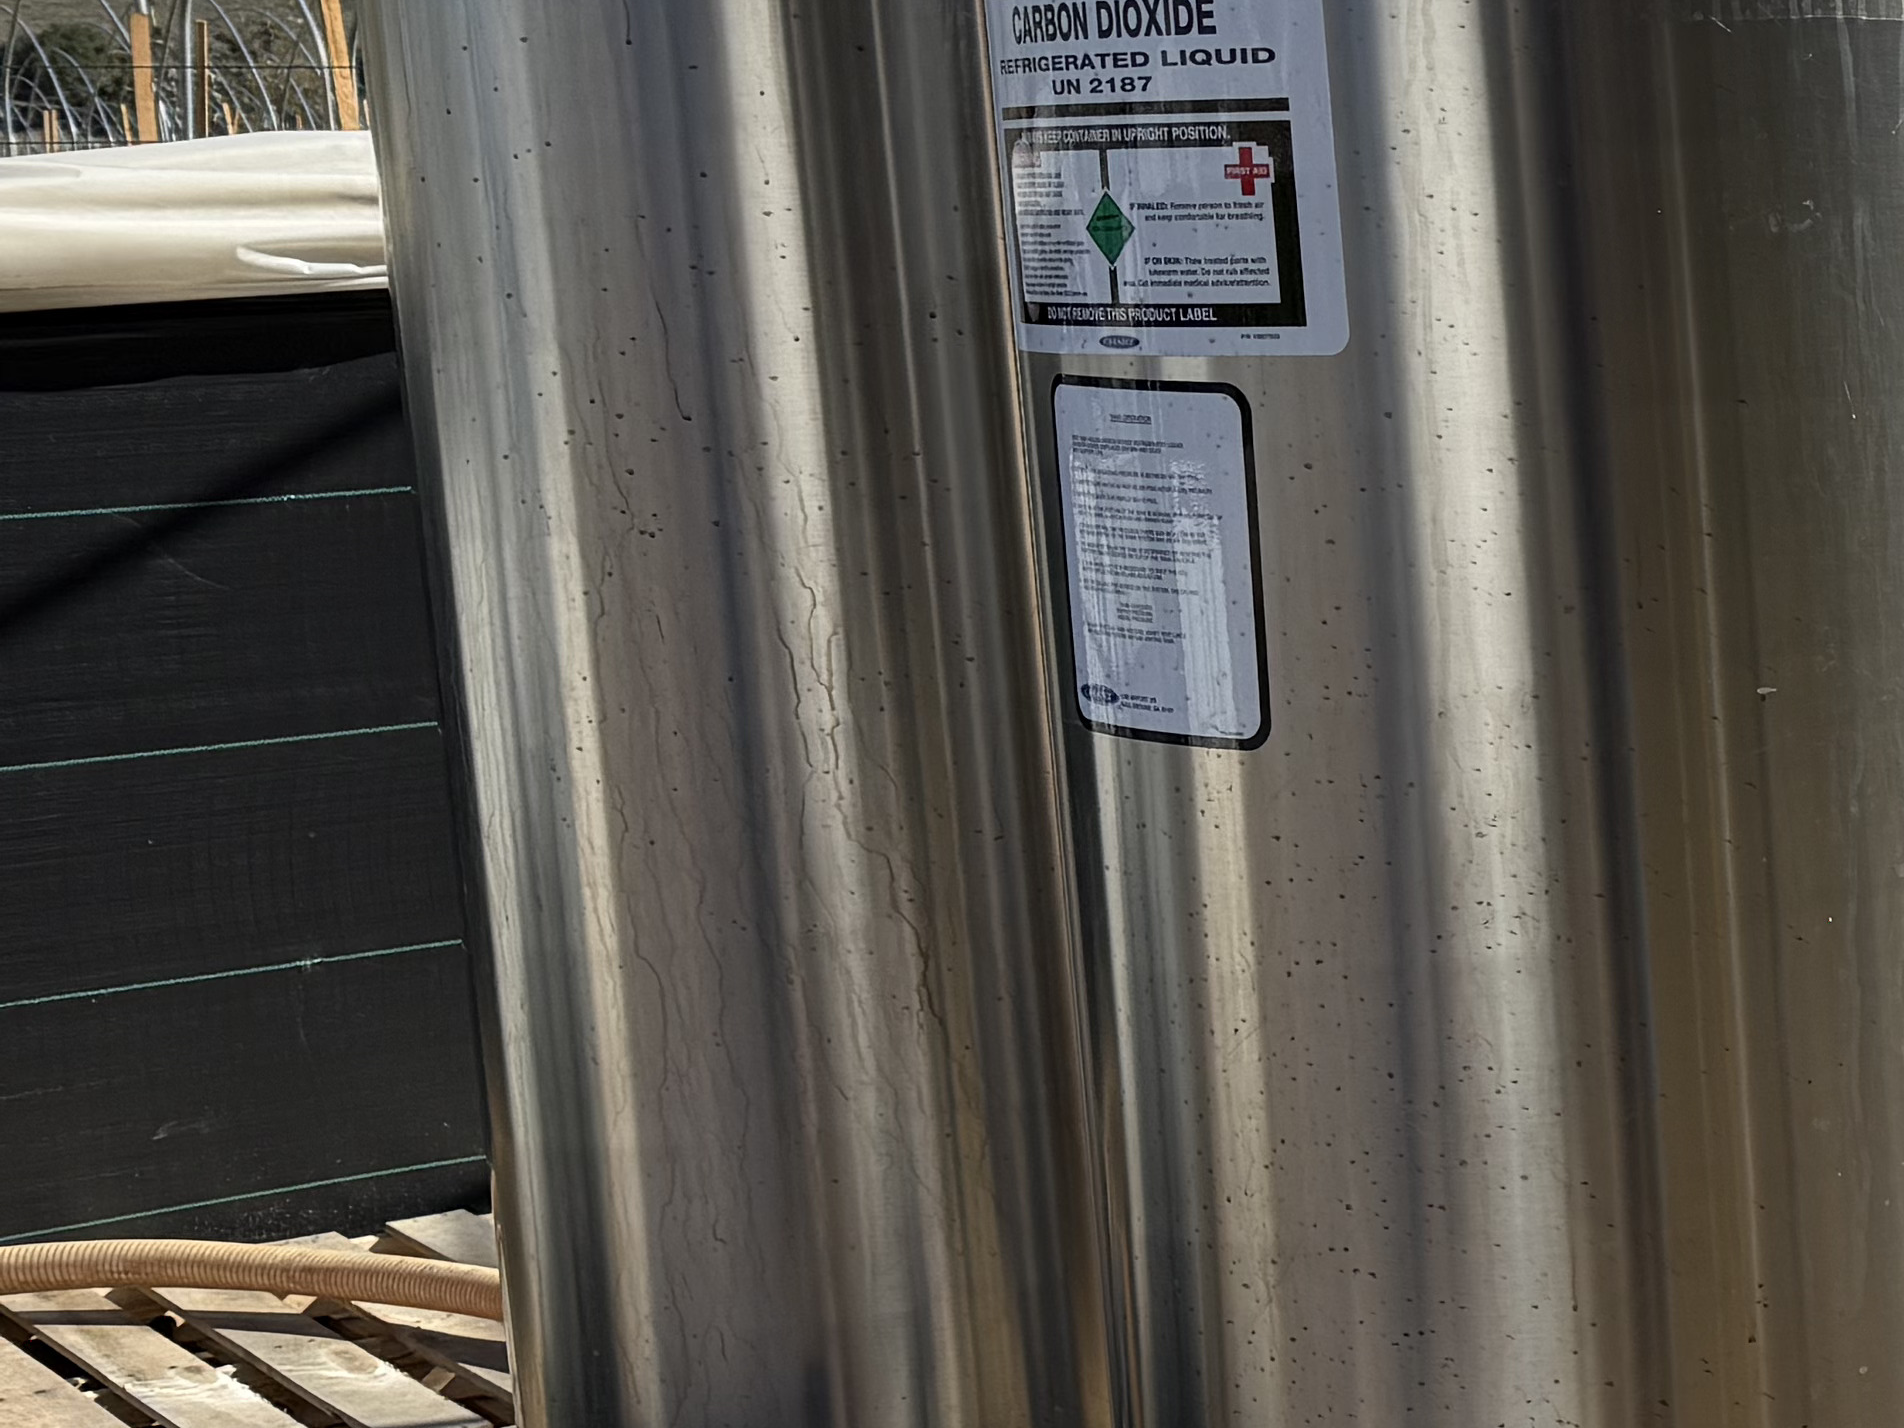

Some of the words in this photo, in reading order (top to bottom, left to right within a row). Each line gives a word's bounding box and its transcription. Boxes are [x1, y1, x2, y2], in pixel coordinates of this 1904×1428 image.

[1000, 52, 1149, 76] REFRIGERATED
[1160, 46, 1276, 68] LIQUID
[1052, 79, 1082, 96] UN
[1089, 75, 1153, 94] 2187
[1063, 128, 1110, 143] CONTAINER
[1111, 128, 1123, 142] IN
[1124, 127, 1169, 142] UPRIGHT
[1171, 125, 1231, 141] POSITION.
[1226, 166, 1250, 177] FIRST
[1251, 165, 1269, 176] AID
[1107, 307, 1128, 321] THIS
[1129, 307, 1177, 321] PRODUCT
[1180, 307, 1217, 321] LABEL
